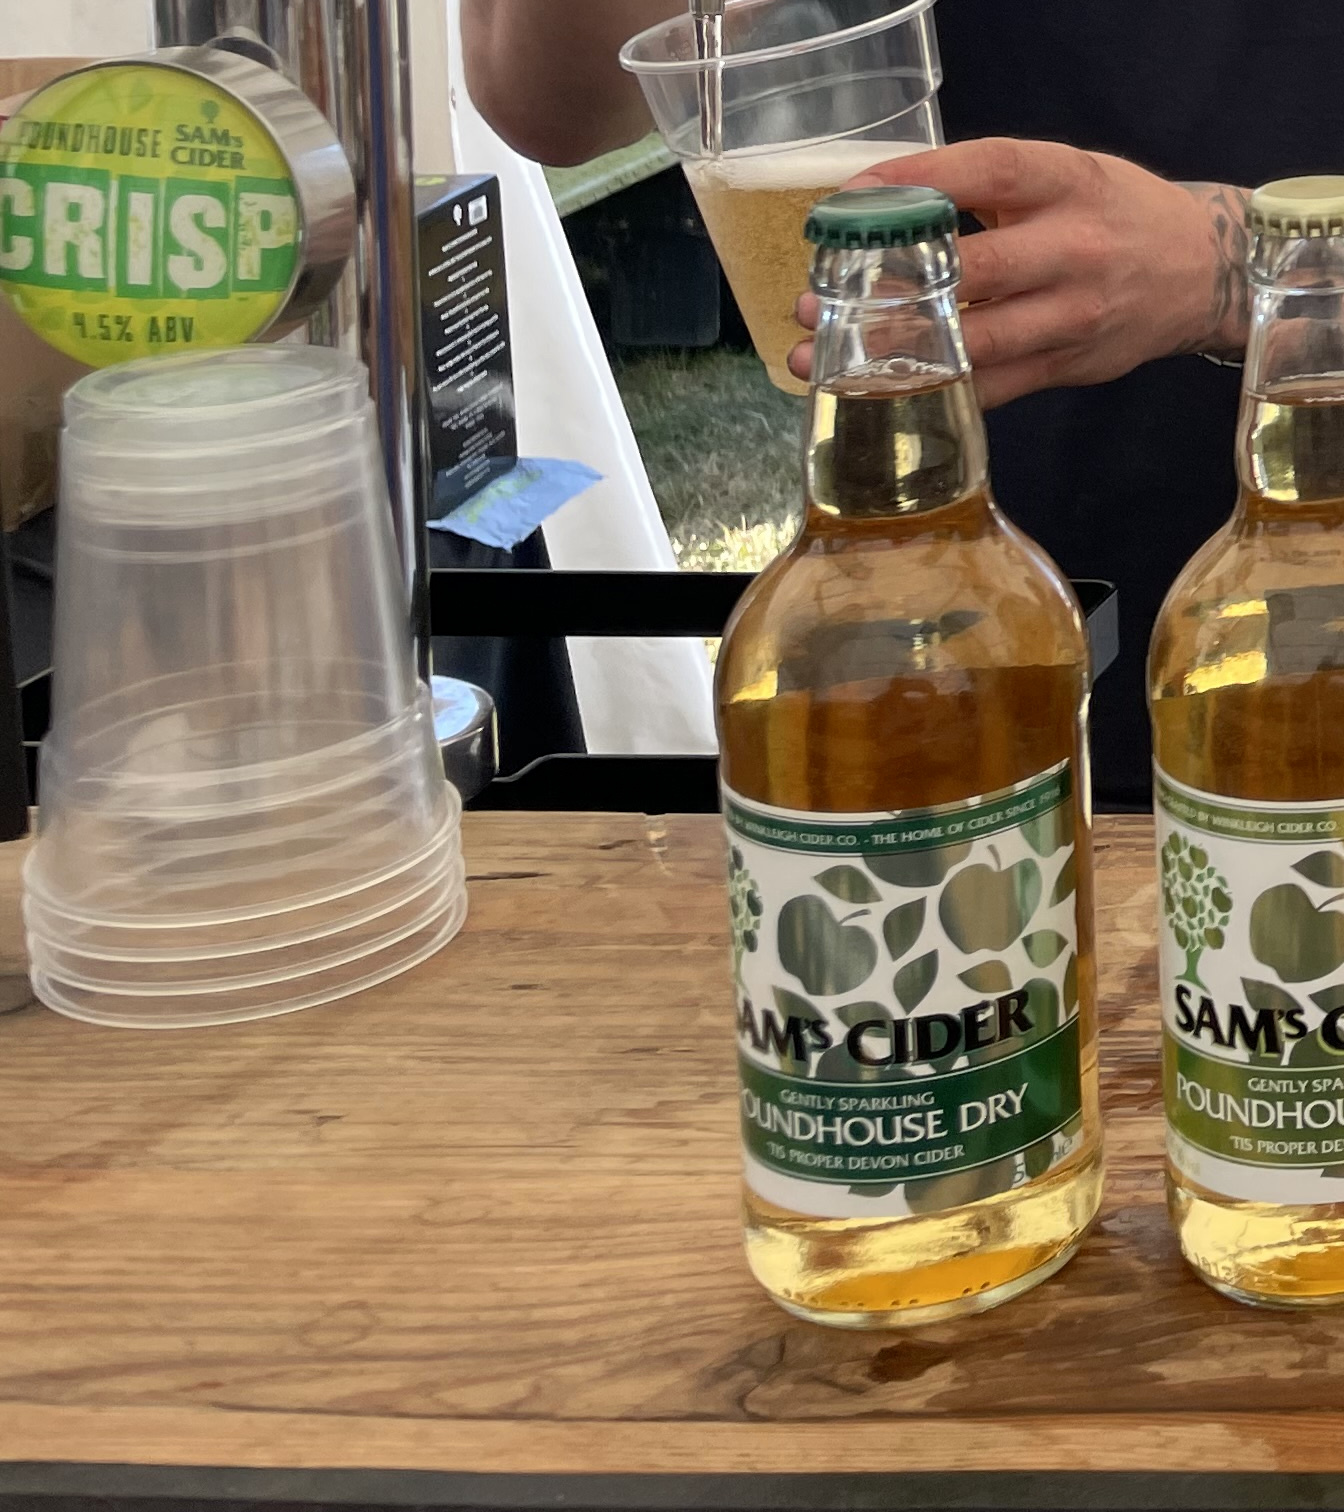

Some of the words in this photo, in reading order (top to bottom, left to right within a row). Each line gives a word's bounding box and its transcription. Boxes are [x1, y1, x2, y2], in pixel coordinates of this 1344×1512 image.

[171, 146, 245, 169] CIDER
[0, 177, 295, 289] CRISP
[148, 315, 194, 343] ABV
[800, 833, 832, 846] CIDER
[872, 833, 897, 845] THE
[901, 826, 944, 843] HOME
[947, 821, 965, 835] OF
[967, 811, 1004, 830] CIDER
[1005, 798, 1037, 819] SINCE
[1277, 822, 1315, 834] CIDER
[847, 988, 1034, 1067] CIDER
[1247, 1075, 1308, 1095] GENTLY
[778, 1089, 835, 1110] GENTLY
[838, 1090, 935, 1112] SPARKLING
[743, 1087, 948, 1146] OUNDHOUSE
[960, 1083, 1029, 1132] DRY
[789, 1146, 844, 1170] PROPER
[848, 1151, 908, 1171] DEVON
[914, 1145, 965, 1166] CIDER
[1257, 1138, 1318, 1156] PROPER
